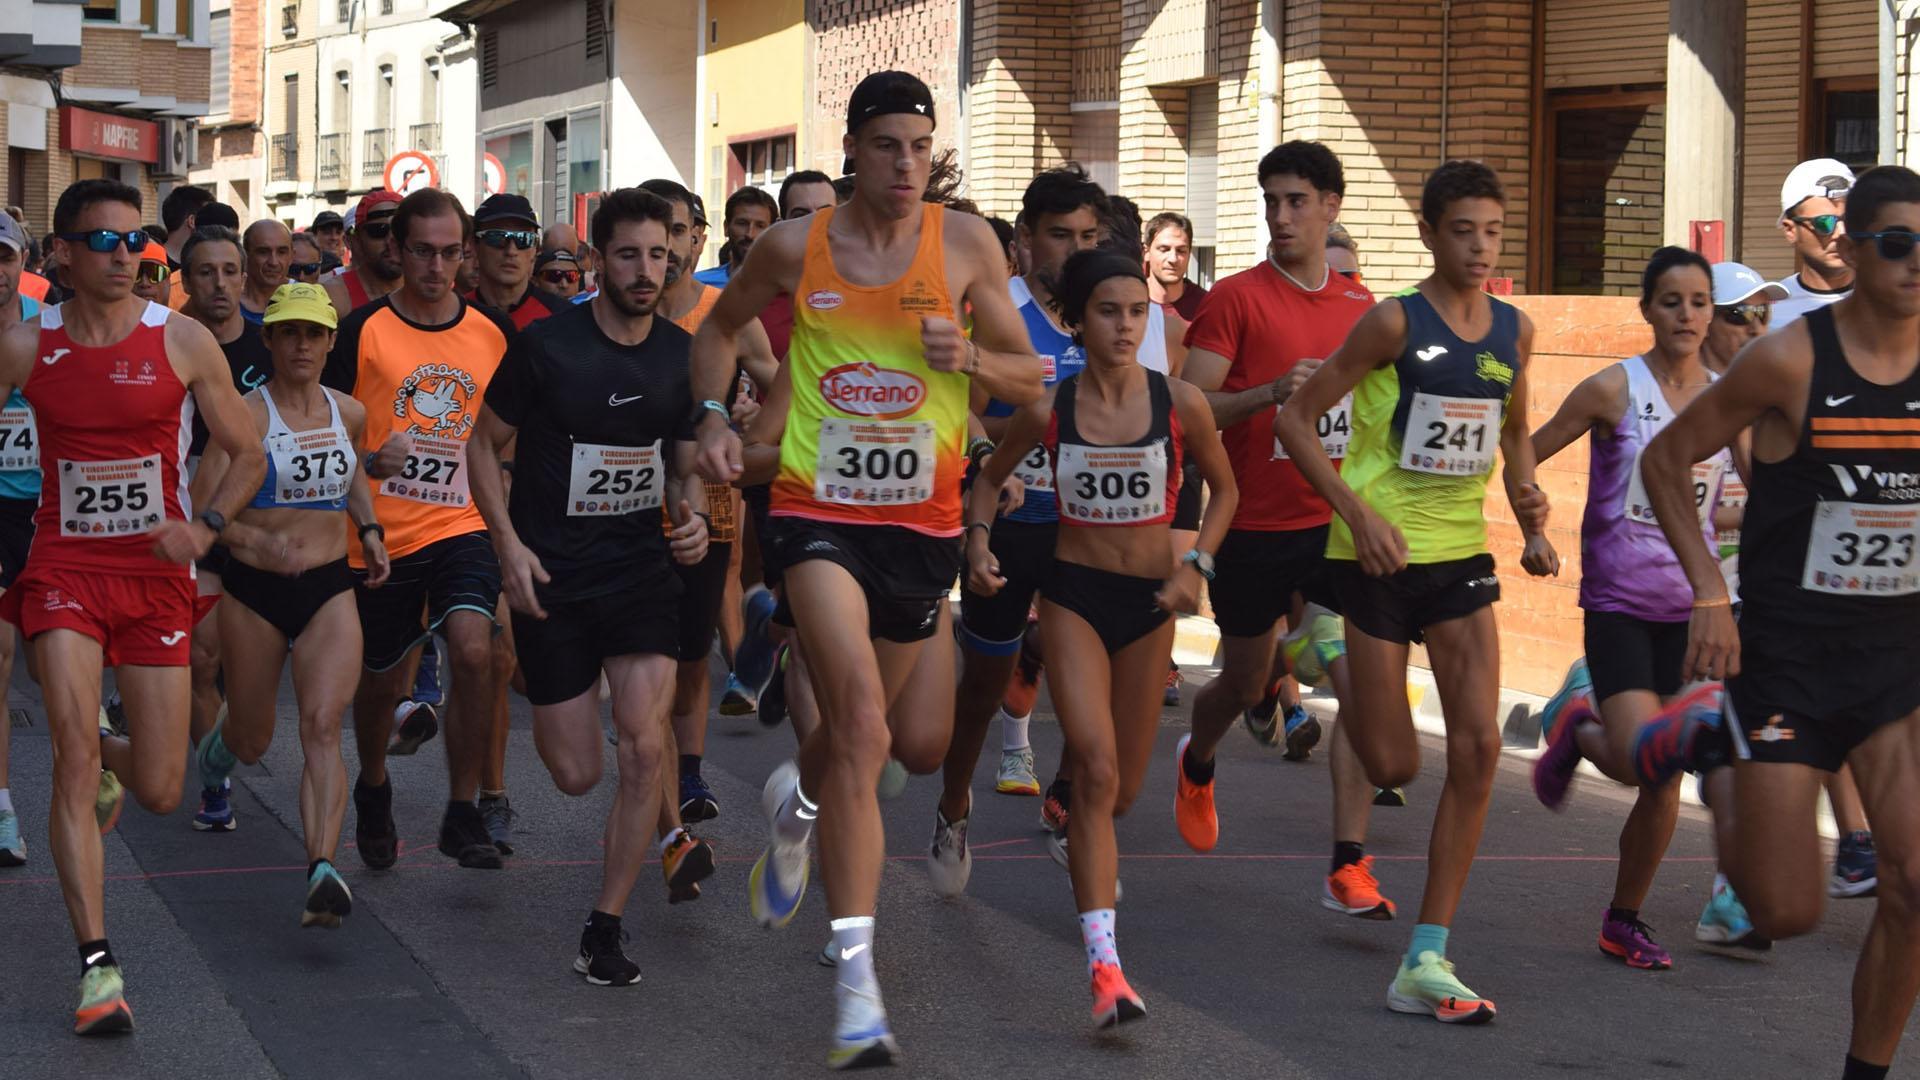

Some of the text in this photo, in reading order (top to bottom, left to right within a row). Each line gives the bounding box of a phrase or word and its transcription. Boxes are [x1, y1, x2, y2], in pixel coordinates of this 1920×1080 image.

[102, 123, 139, 150] MAPFRE
[824, 376, 919, 403] Serrano
[1423, 421, 1486, 453] 241
[291, 449, 348, 482] 373
[400, 455, 460, 486] 327
[836, 447, 918, 480] 300
[586, 467, 655, 495] 252
[1075, 471, 1150, 500] 306
[75, 482, 149, 514] 255
[1830, 532, 1915, 567] 323
